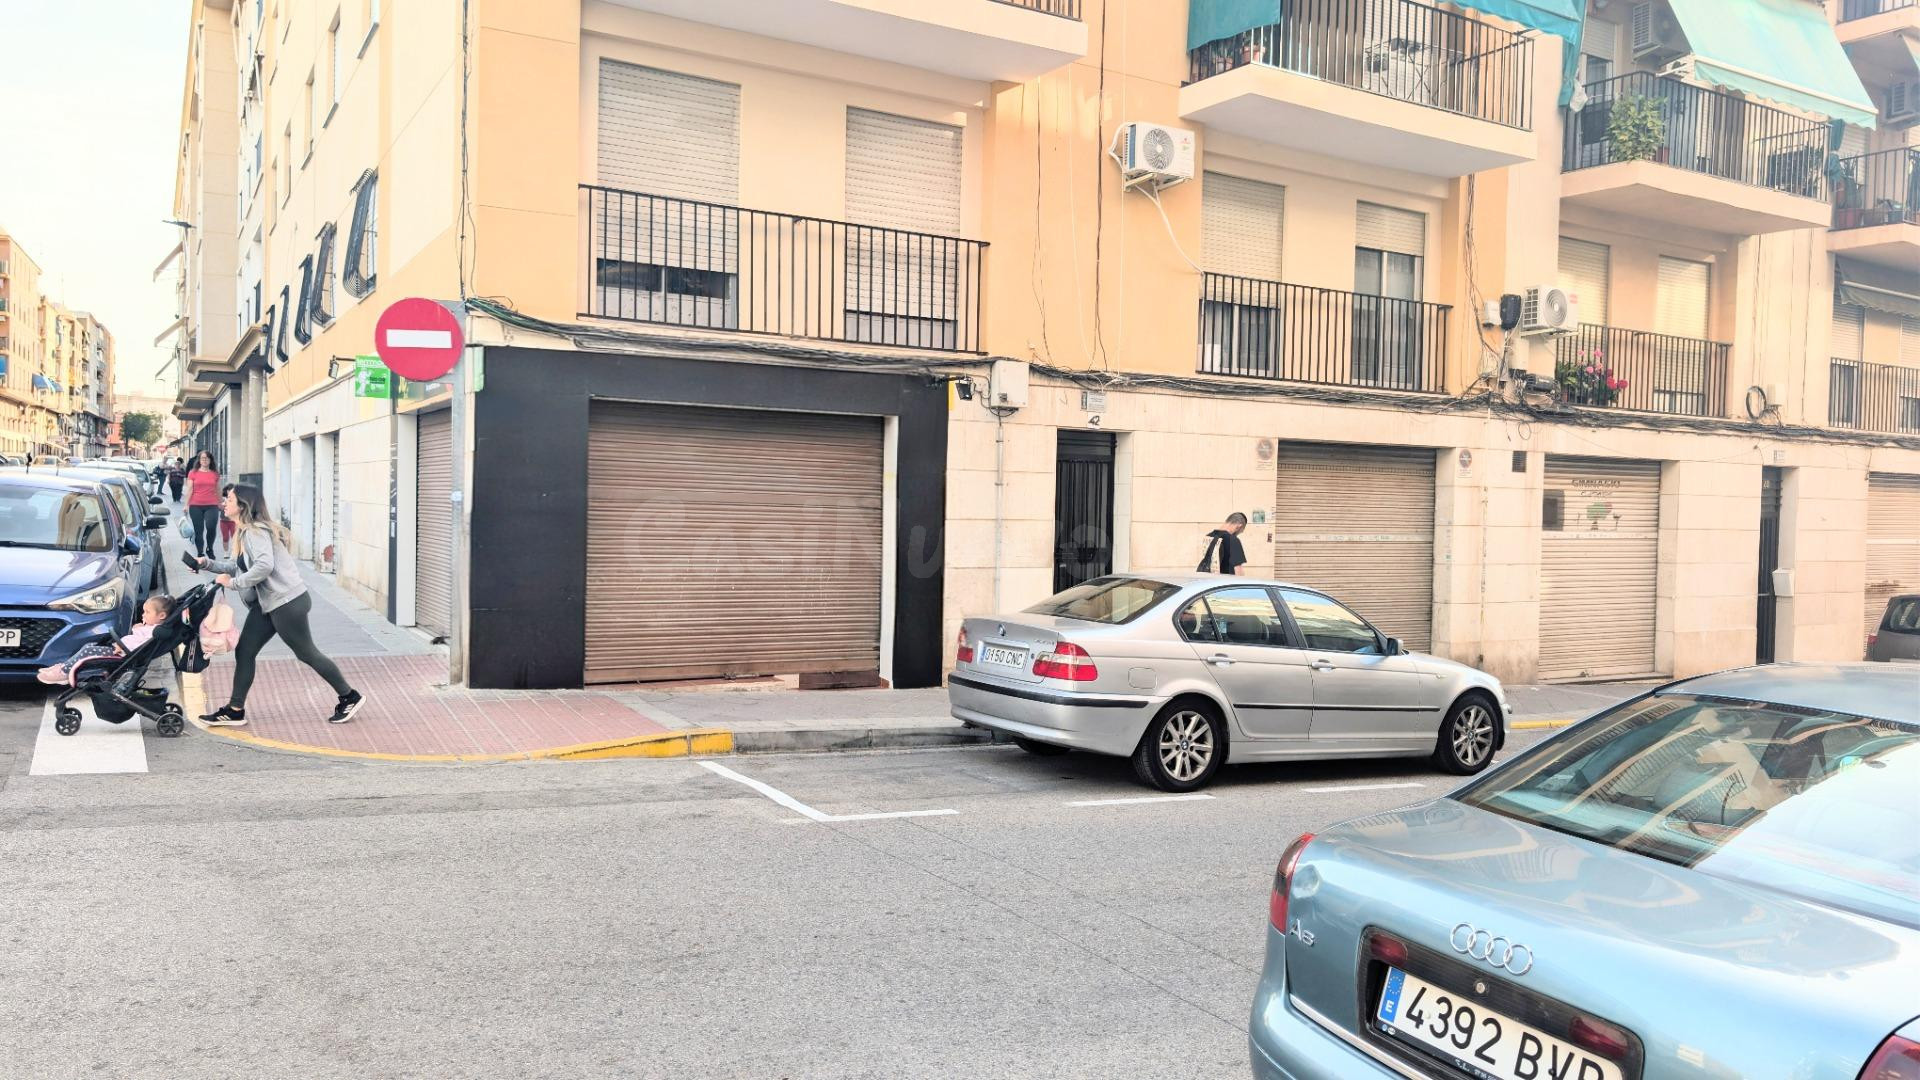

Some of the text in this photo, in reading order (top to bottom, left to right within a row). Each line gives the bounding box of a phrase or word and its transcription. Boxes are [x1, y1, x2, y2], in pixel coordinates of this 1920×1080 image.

[1088, 415, 1100, 426] 42
[1005, 651, 1023, 666] CNC
[1385, 999, 1395, 1014] E
[1405, 986, 1503, 1066] 4392
